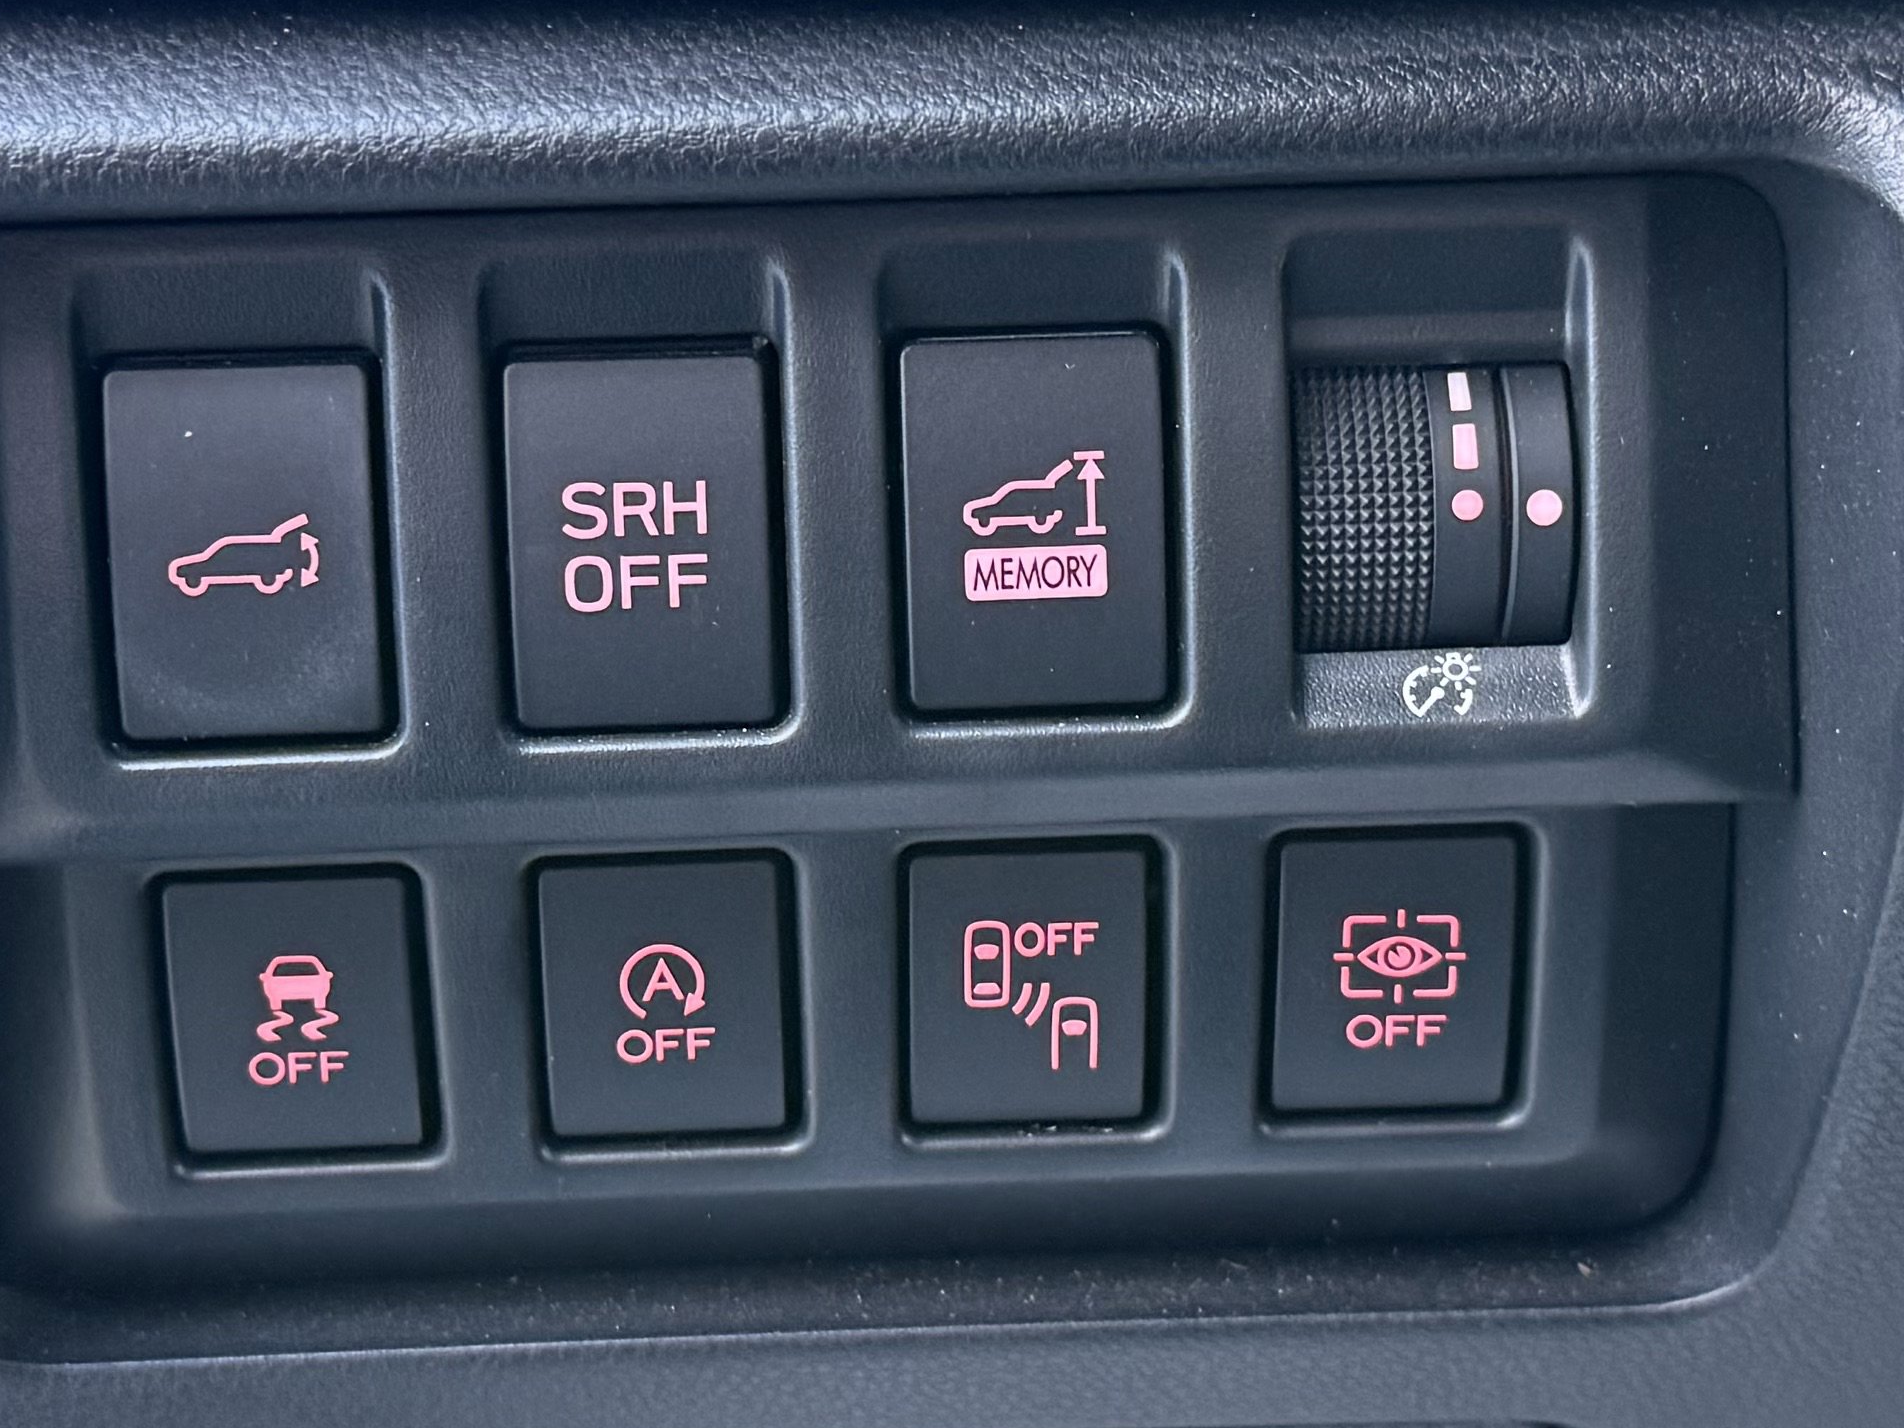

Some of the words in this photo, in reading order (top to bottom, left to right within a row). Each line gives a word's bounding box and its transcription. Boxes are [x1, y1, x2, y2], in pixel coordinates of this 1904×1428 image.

[561, 479, 709, 540] SRH
[563, 553, 709, 613] OFF
[973, 554, 1098, 591] MEMORY
[1014, 921, 1100, 958] OFF
[642, 958, 684, 1002] A
[616, 1026, 716, 1064] OFF
[1345, 1014, 1448, 1049] OFF
[248, 1050, 350, 1086] OFF
